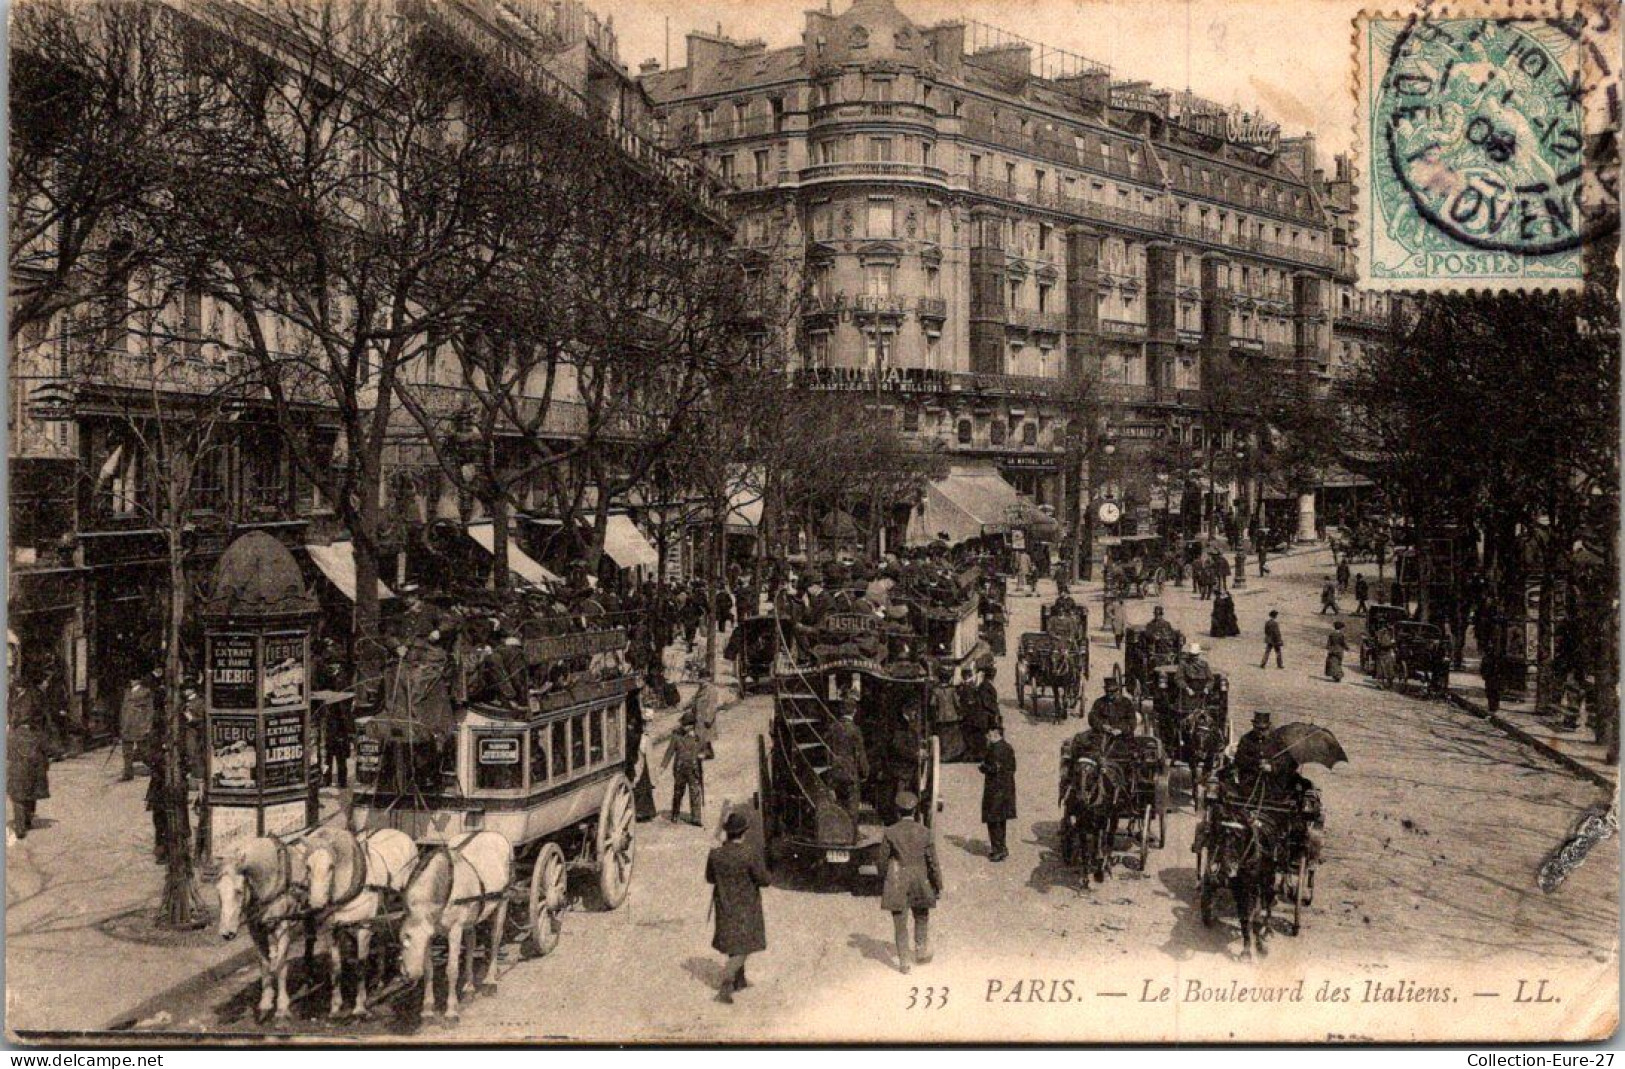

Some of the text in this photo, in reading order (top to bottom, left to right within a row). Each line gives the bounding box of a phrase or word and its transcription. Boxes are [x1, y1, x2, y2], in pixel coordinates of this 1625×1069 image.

[1428, 252, 1522, 275] POSTES
[214, 648, 253, 657] EXTRAIT
[265, 643, 303, 664] LIEBIG
[213, 669, 254, 683] LIEBIG
[213, 725, 256, 745] LIEBIG
[267, 724, 302, 736] EXTRAIT
[265, 745, 303, 763] LIEBIG
